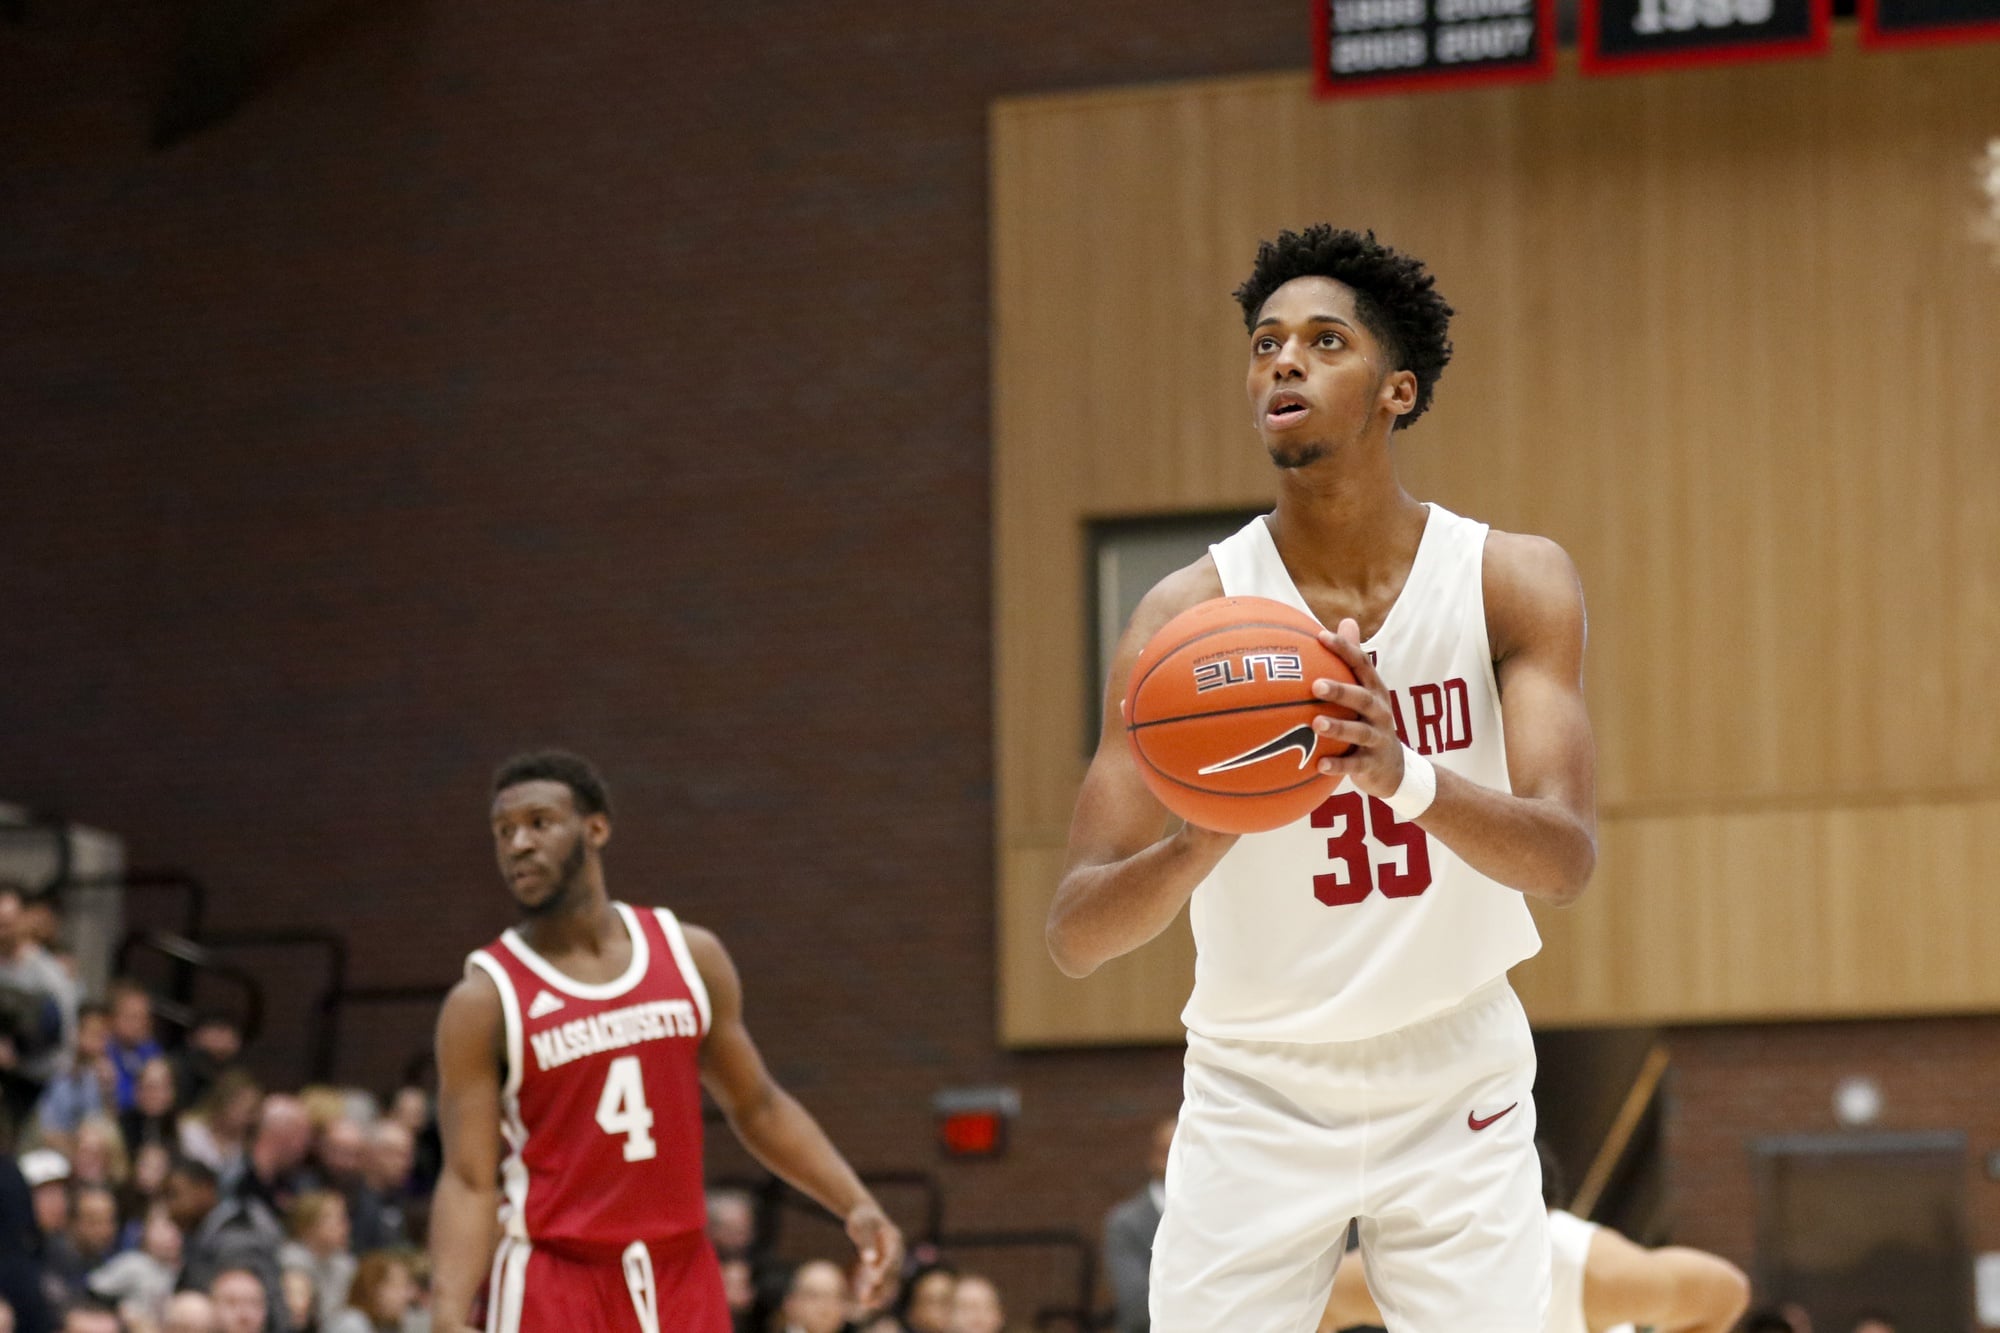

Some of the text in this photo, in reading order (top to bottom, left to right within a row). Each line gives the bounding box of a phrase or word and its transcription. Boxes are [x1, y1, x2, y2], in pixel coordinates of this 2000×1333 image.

[1194, 654, 1303, 694] ELITE
[1310, 791, 1432, 906] 35
[530, 1000, 697, 1071] MASSACHUSETTS
[595, 1056, 657, 1162] 4
